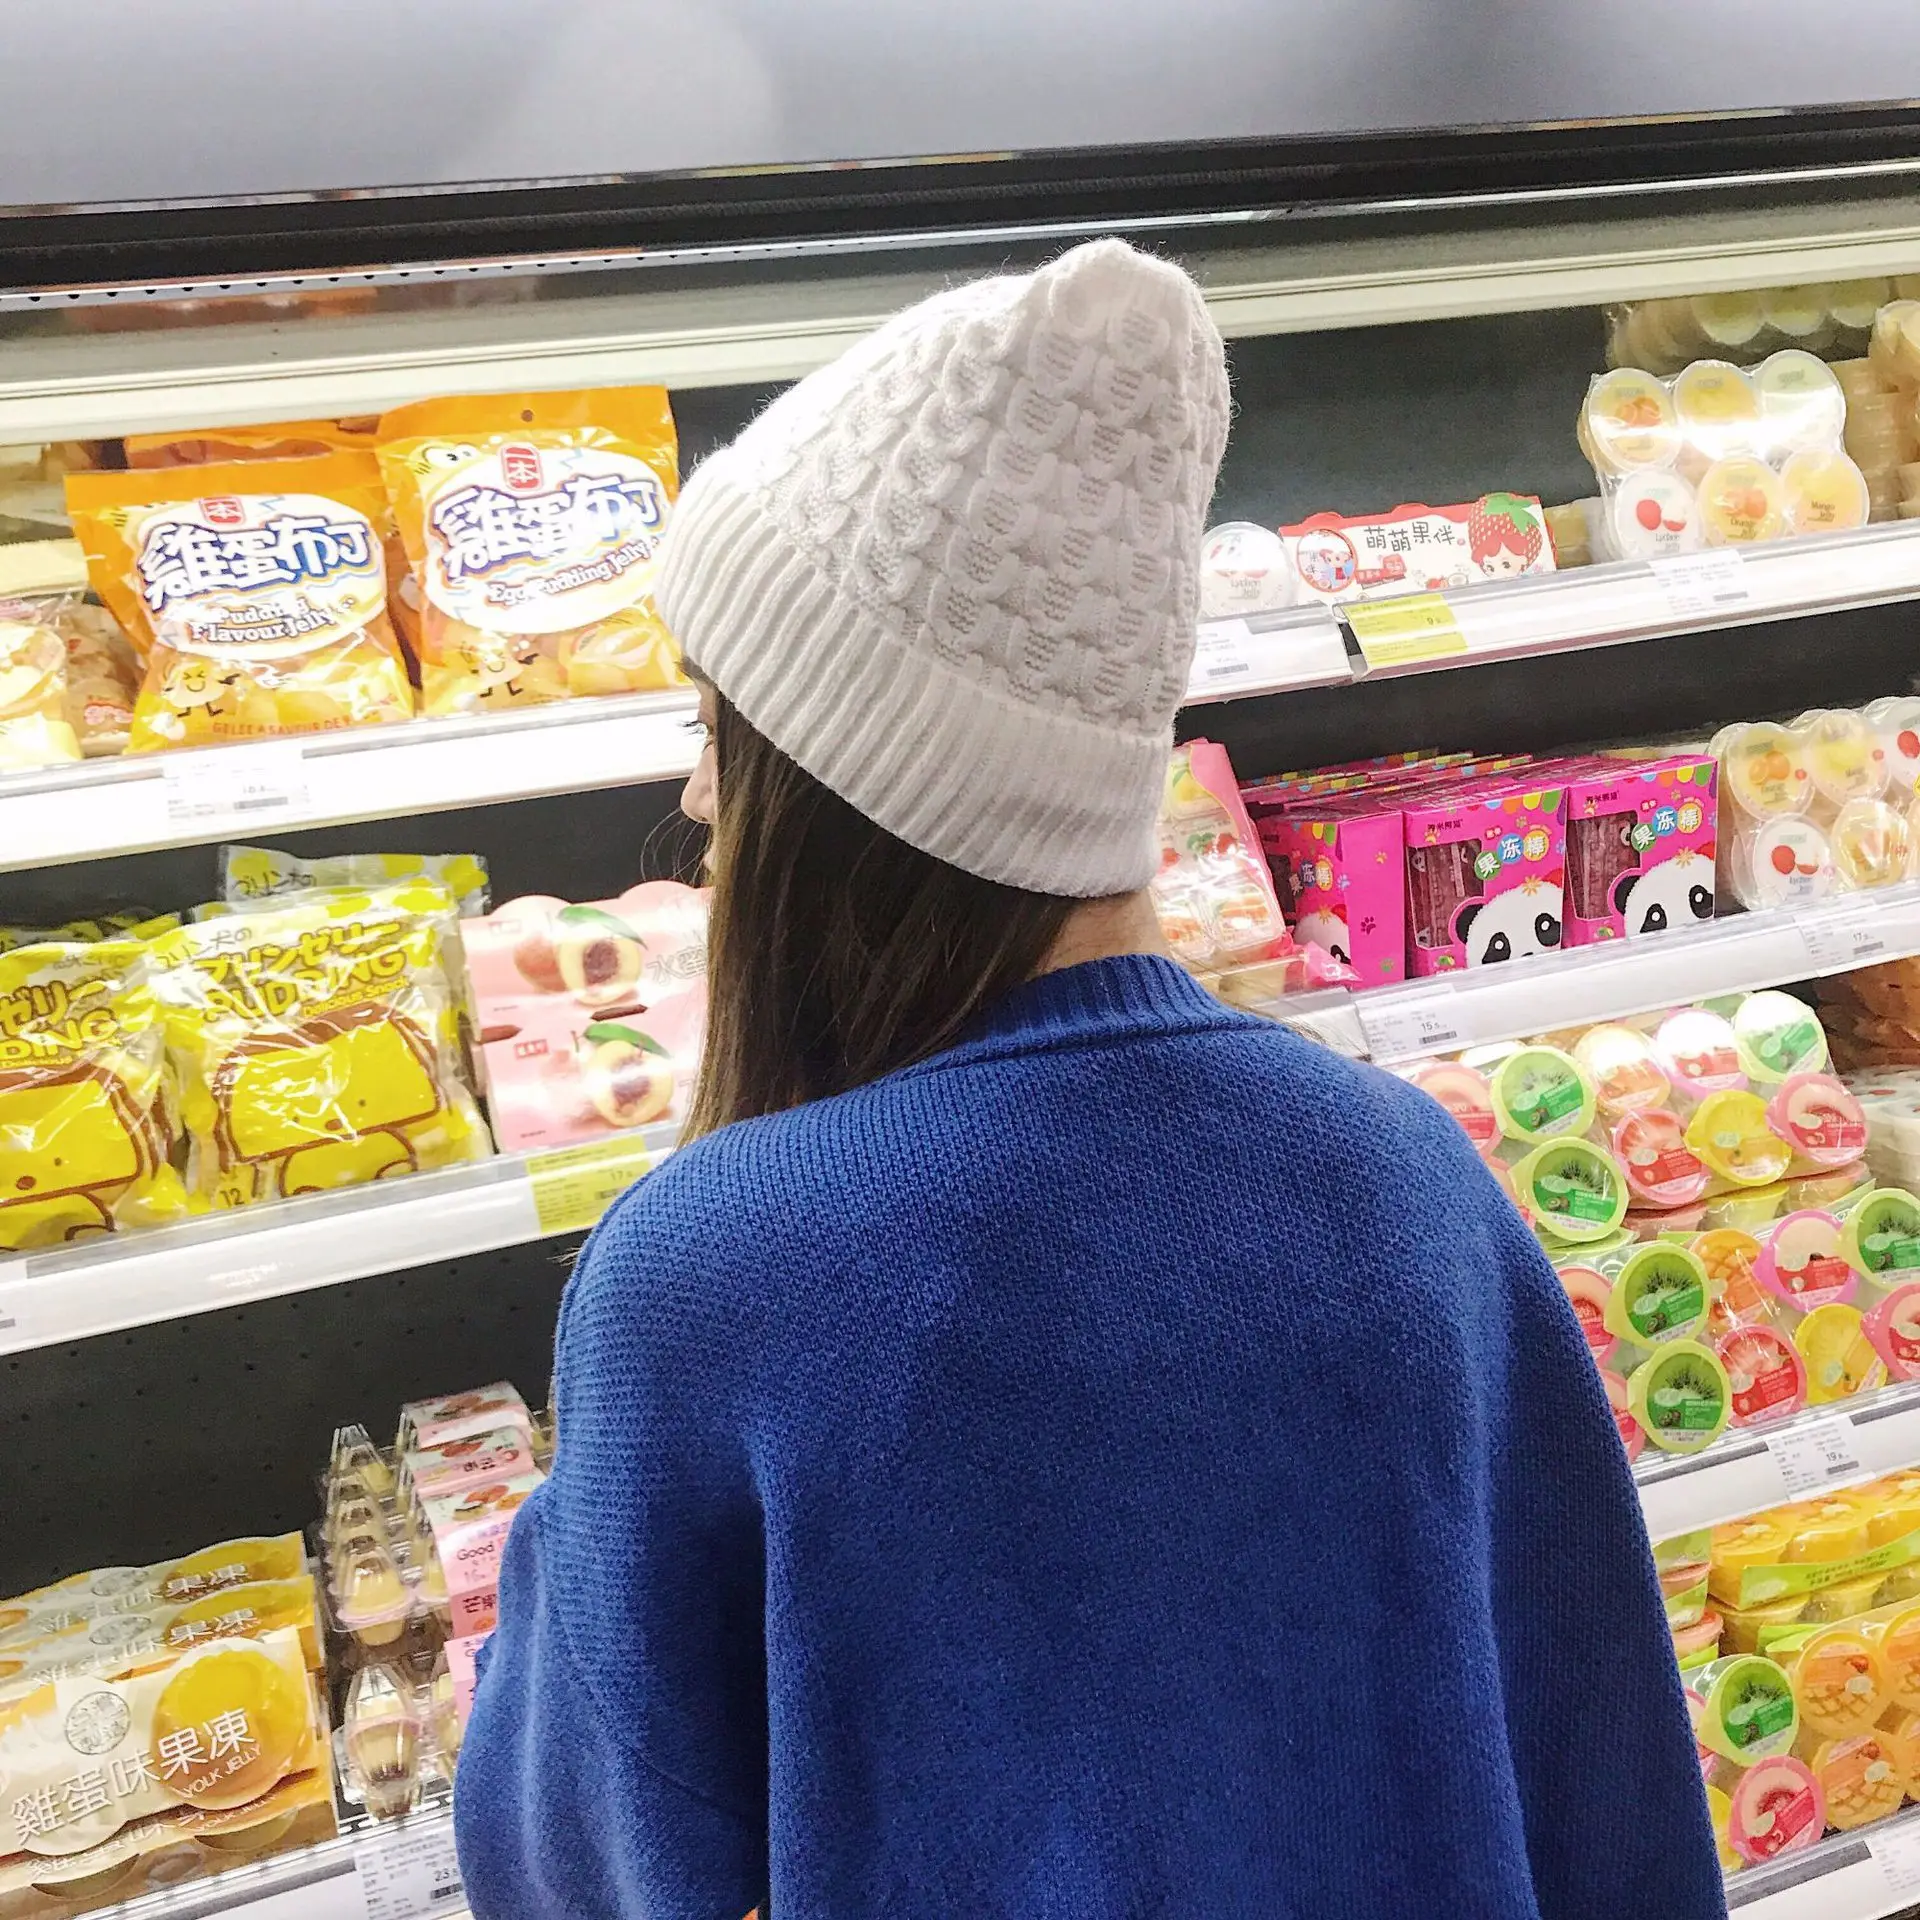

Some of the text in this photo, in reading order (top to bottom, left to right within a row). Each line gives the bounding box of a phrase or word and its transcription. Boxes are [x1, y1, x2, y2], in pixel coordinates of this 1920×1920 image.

[1363, 520, 1456, 552] 萌萌果伴
[605, 539, 651, 575] Jelly
[190, 608, 337, 643] Flavour Jelly
[219, 1187, 245, 1208] 12
[457, 1543, 495, 1561] Good
[10, 1706, 257, 1847] 雞蛋味果凍
[184, 1743, 262, 1800] YOLK JELLY
